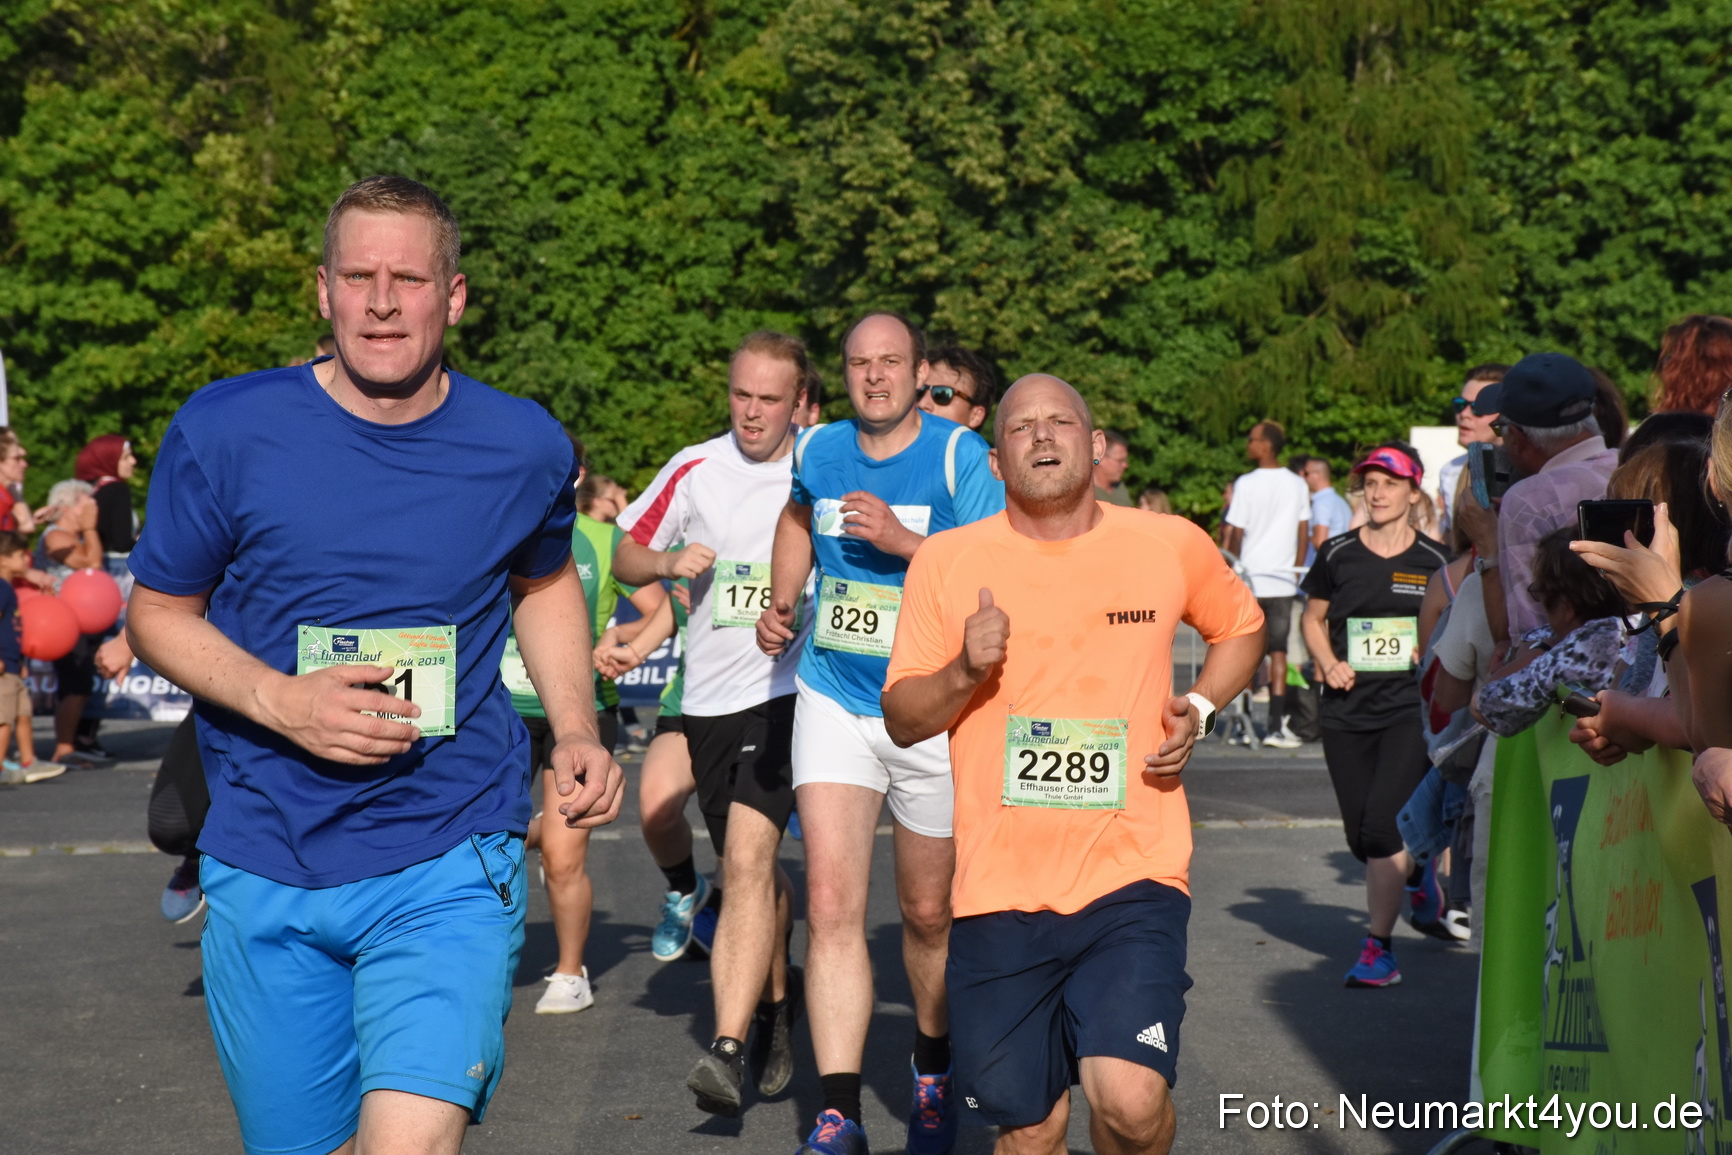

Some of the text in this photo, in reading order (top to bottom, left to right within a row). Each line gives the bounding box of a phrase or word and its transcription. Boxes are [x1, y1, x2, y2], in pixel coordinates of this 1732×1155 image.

[830, 604, 879, 635] 829
[1106, 609, 1156, 625] THULE
[851, 633, 883, 645] Christian
[1362, 637, 1401, 656] 129
[321, 649, 383, 662] firmenlauf
[417, 656, 446, 667] 2019
[1022, 733, 1070, 745] firmenlauf
[1097, 742, 1120, 751] 2019
[1017, 749, 1110, 784] 2289
[1020, 782, 1109, 794] Effhauser Christian
[1064, 793, 1084, 801] GmbH
[1136, 1033, 1168, 1053] adidas
[965, 1096, 979, 1109] EC
